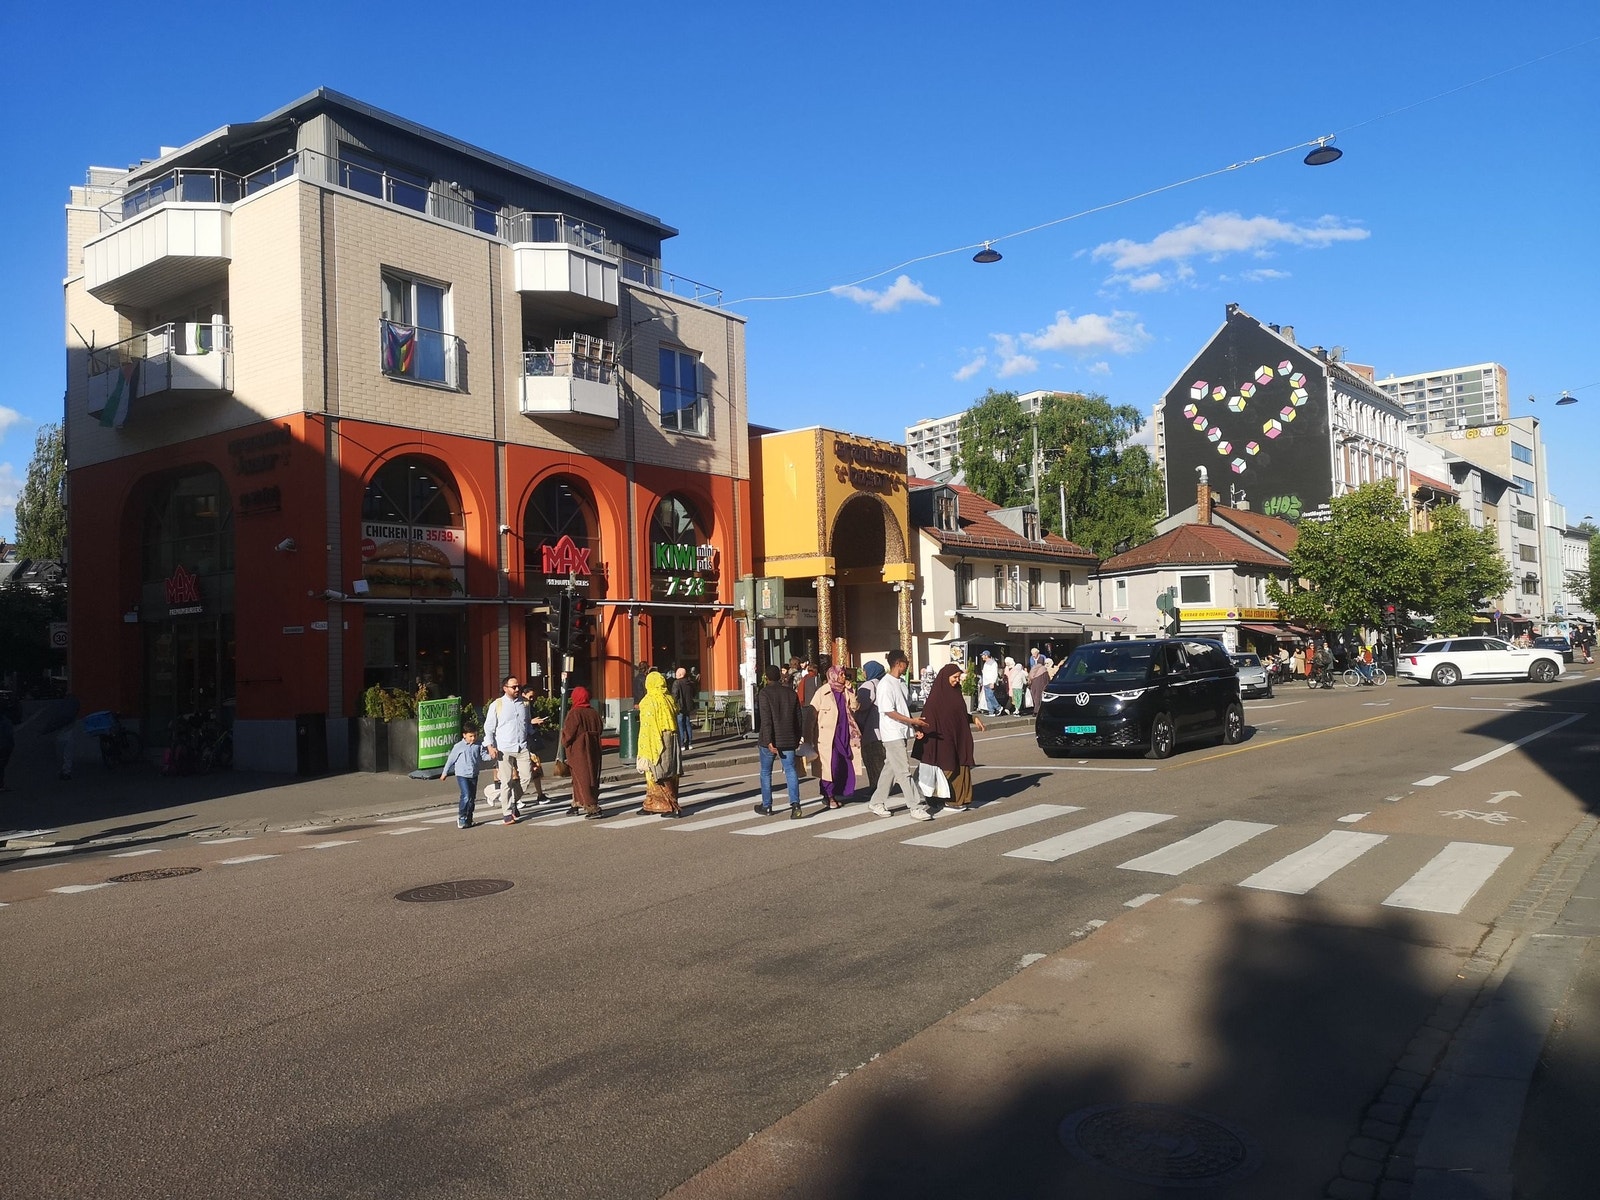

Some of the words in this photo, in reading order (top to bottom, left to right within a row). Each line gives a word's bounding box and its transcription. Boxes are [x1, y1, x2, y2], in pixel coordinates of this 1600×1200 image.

[366, 525, 407, 539] CHICKEN
[543, 535, 591, 575] MAX
[656, 543, 696, 569] KIWI
[697, 545, 713, 556] min
[164, 564, 198, 604] MAX
[56, 634, 67, 642] 30
[420, 702, 448, 720] KIWI
[420, 733, 459, 749] INNGANG
